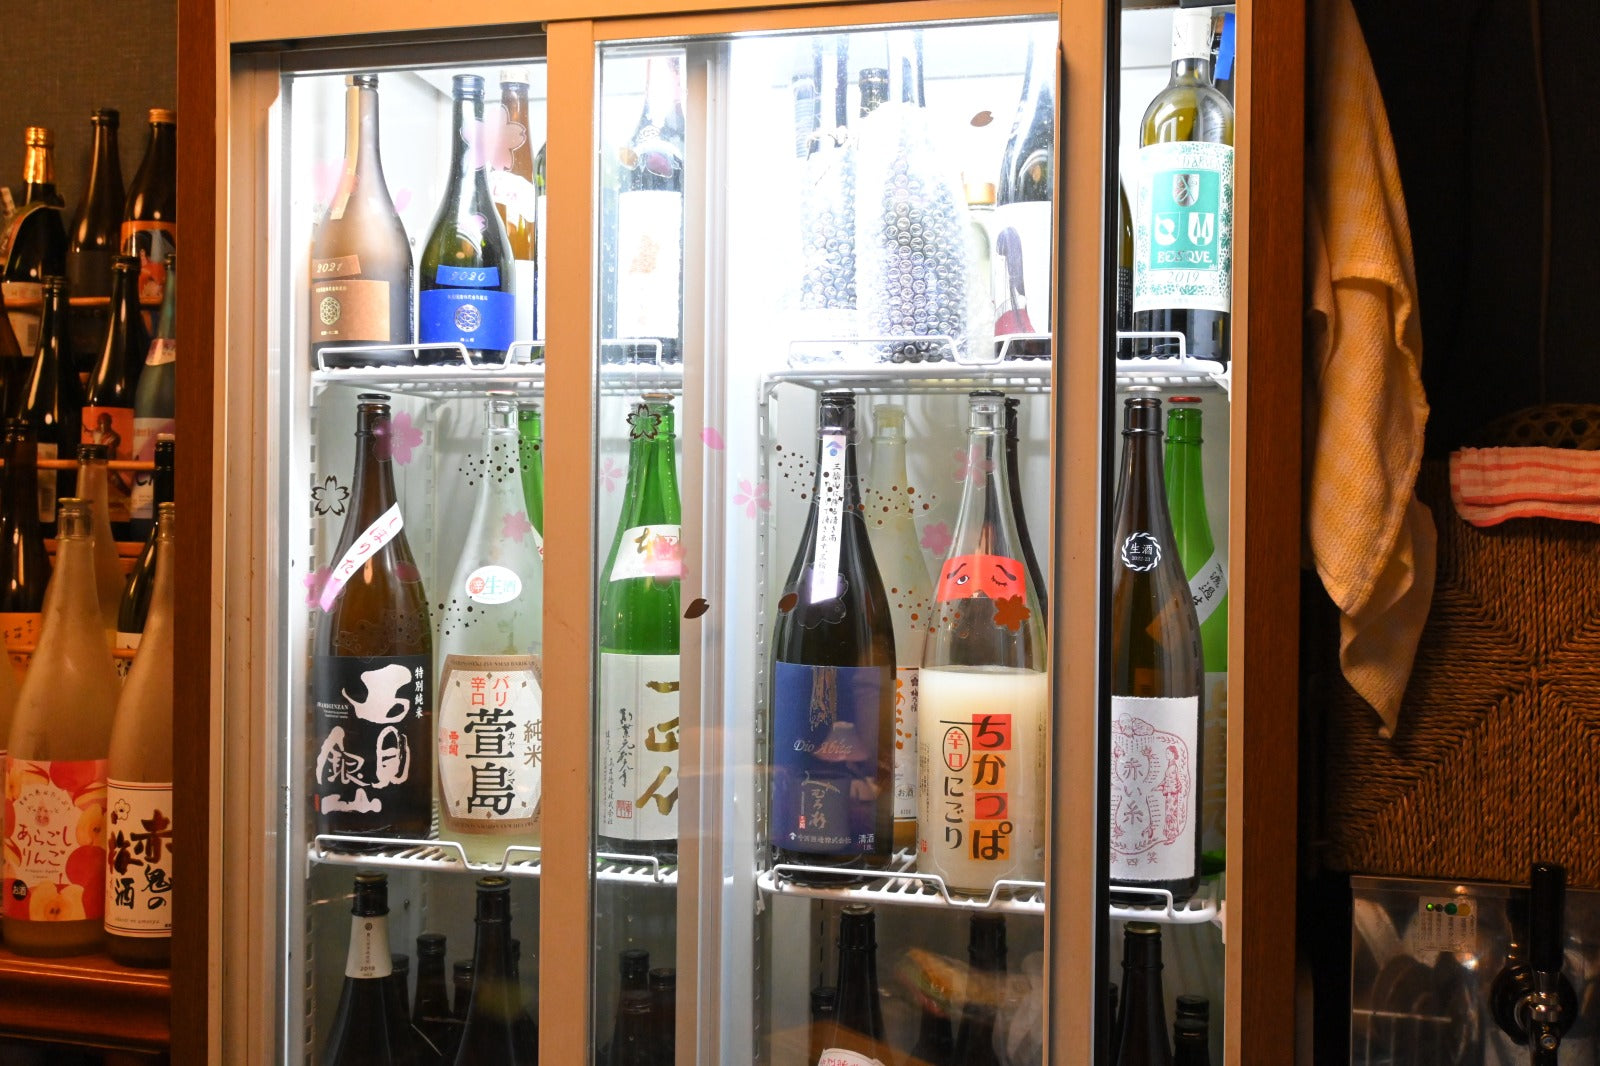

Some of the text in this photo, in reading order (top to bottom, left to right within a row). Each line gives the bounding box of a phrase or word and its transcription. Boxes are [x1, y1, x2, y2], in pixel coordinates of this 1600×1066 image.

[316, 262, 343, 274] 2021
[1130, 543, 1153, 555] 生酒
[414, 666, 424, 718] 特別純米
[470, 676, 487, 706] 辛口
[493, 675, 511, 707] バリ
[523, 718, 542, 768] 純米
[793, 738, 815, 753] Dio
[946, 730, 965, 768] 辛口
[463, 707, 517, 816] 萱島
[1122, 756, 1144, 825] 赤い糸
[943, 775, 965, 850] にごり
[17, 822, 73, 848] あらごし
[858, 833, 875, 844] 清酒
[22, 849, 66, 867] りんご
